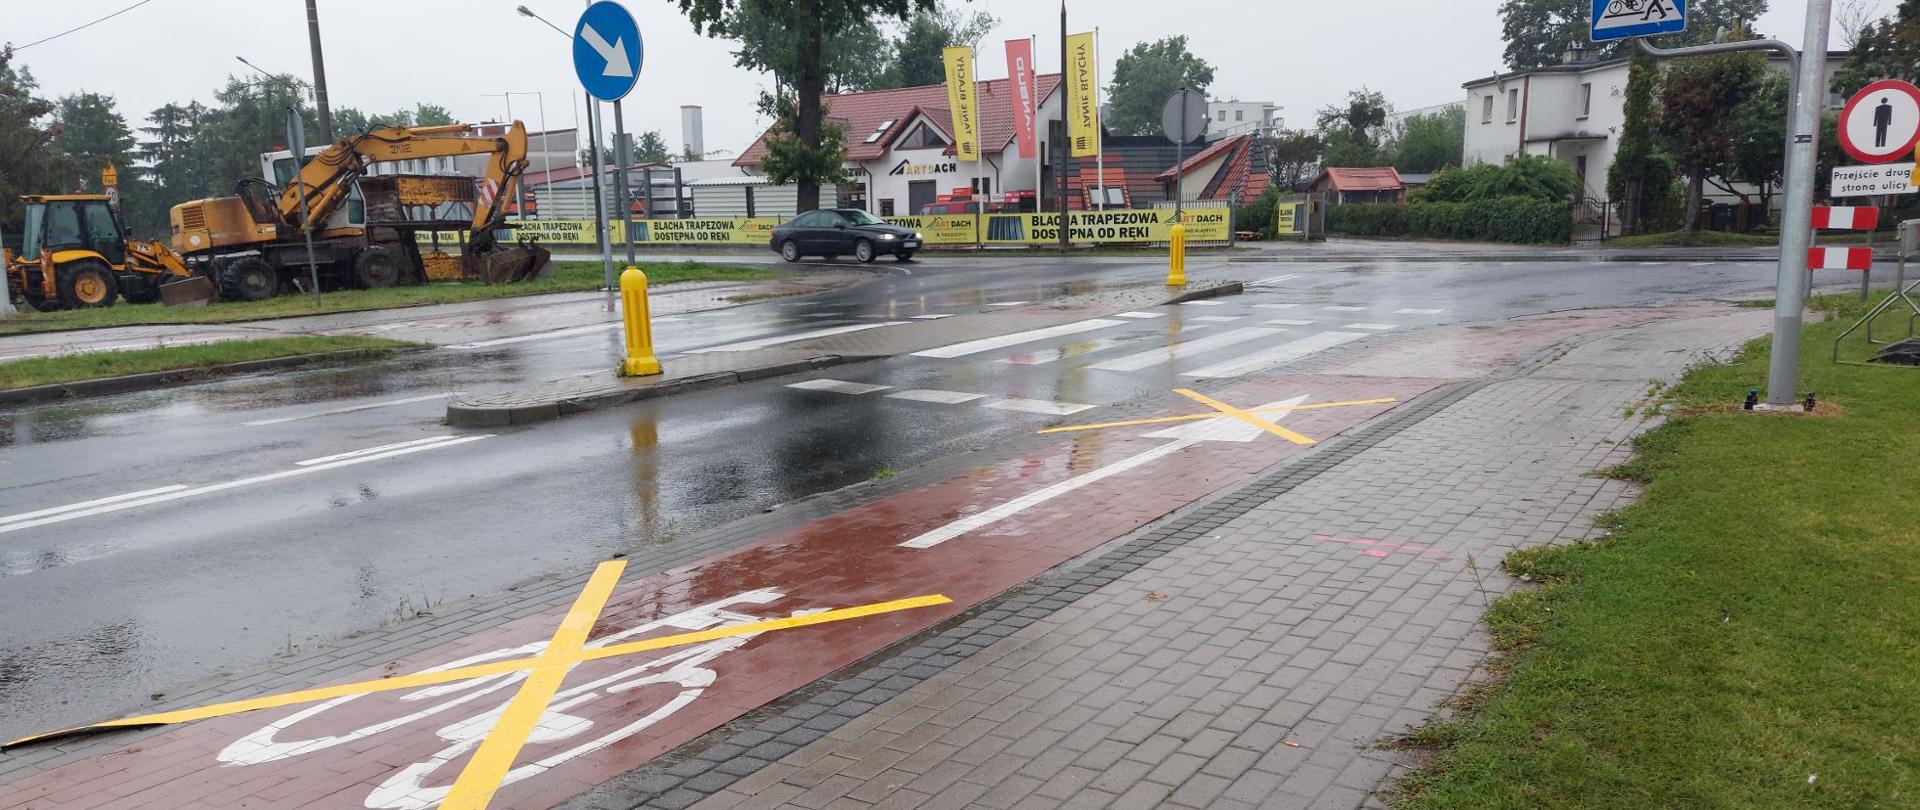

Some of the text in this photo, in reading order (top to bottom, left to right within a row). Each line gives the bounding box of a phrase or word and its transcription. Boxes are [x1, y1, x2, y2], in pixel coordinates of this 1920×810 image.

[1885, 168, 1911, 179] drug
[1882, 180, 1907, 191] ulicy
[1032, 213, 1158, 226] BLACA TRAPEZOWA
[542, 222, 583, 231] TRAPEZOWA
[654, 220, 735, 231] BLACHA TRAPEZOWA
[696, 231, 708, 241] OD
[1032, 227, 1149, 240] DOSTPNA OD RĘKI
